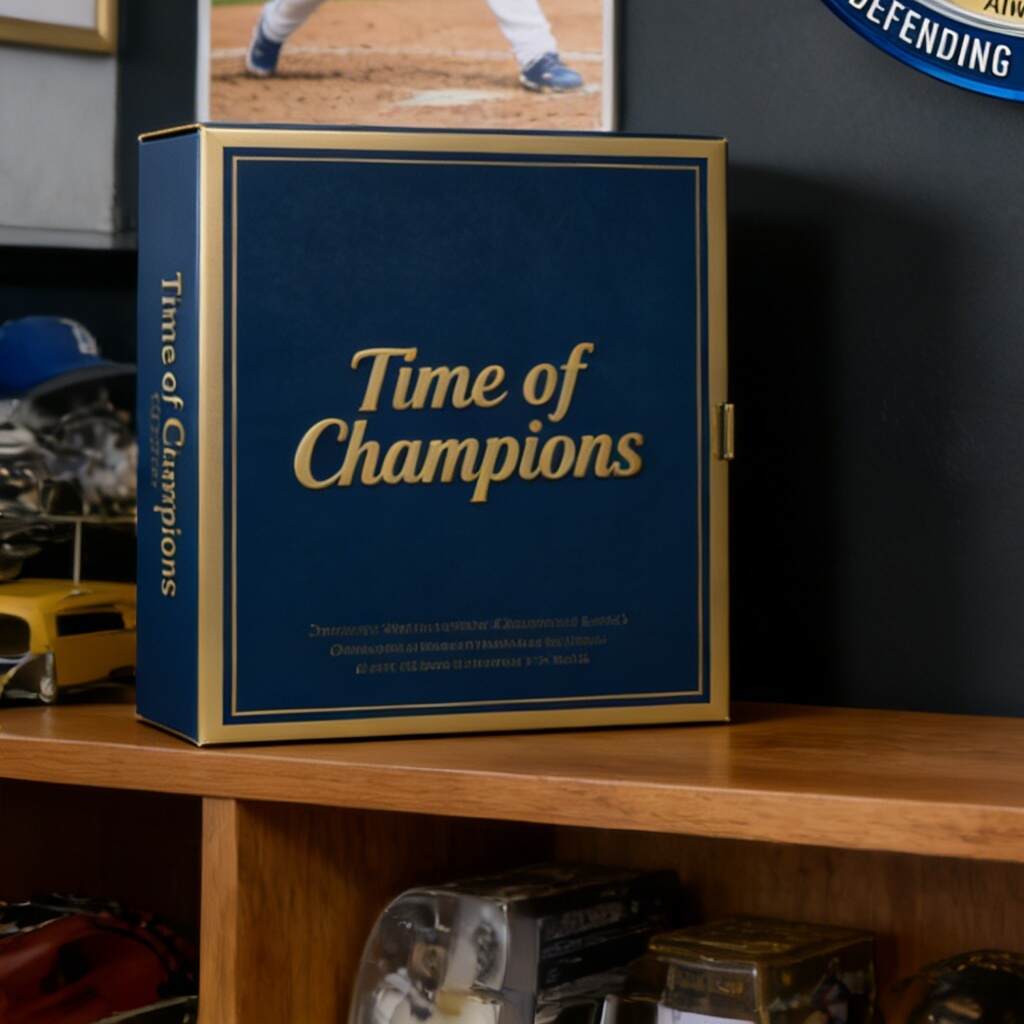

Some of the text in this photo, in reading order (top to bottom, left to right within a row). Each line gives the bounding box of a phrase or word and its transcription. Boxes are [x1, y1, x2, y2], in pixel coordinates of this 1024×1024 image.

[161, 372, 185, 410] of
[350, 342, 595, 422] Time of
[293, 417, 645, 503] Champions
